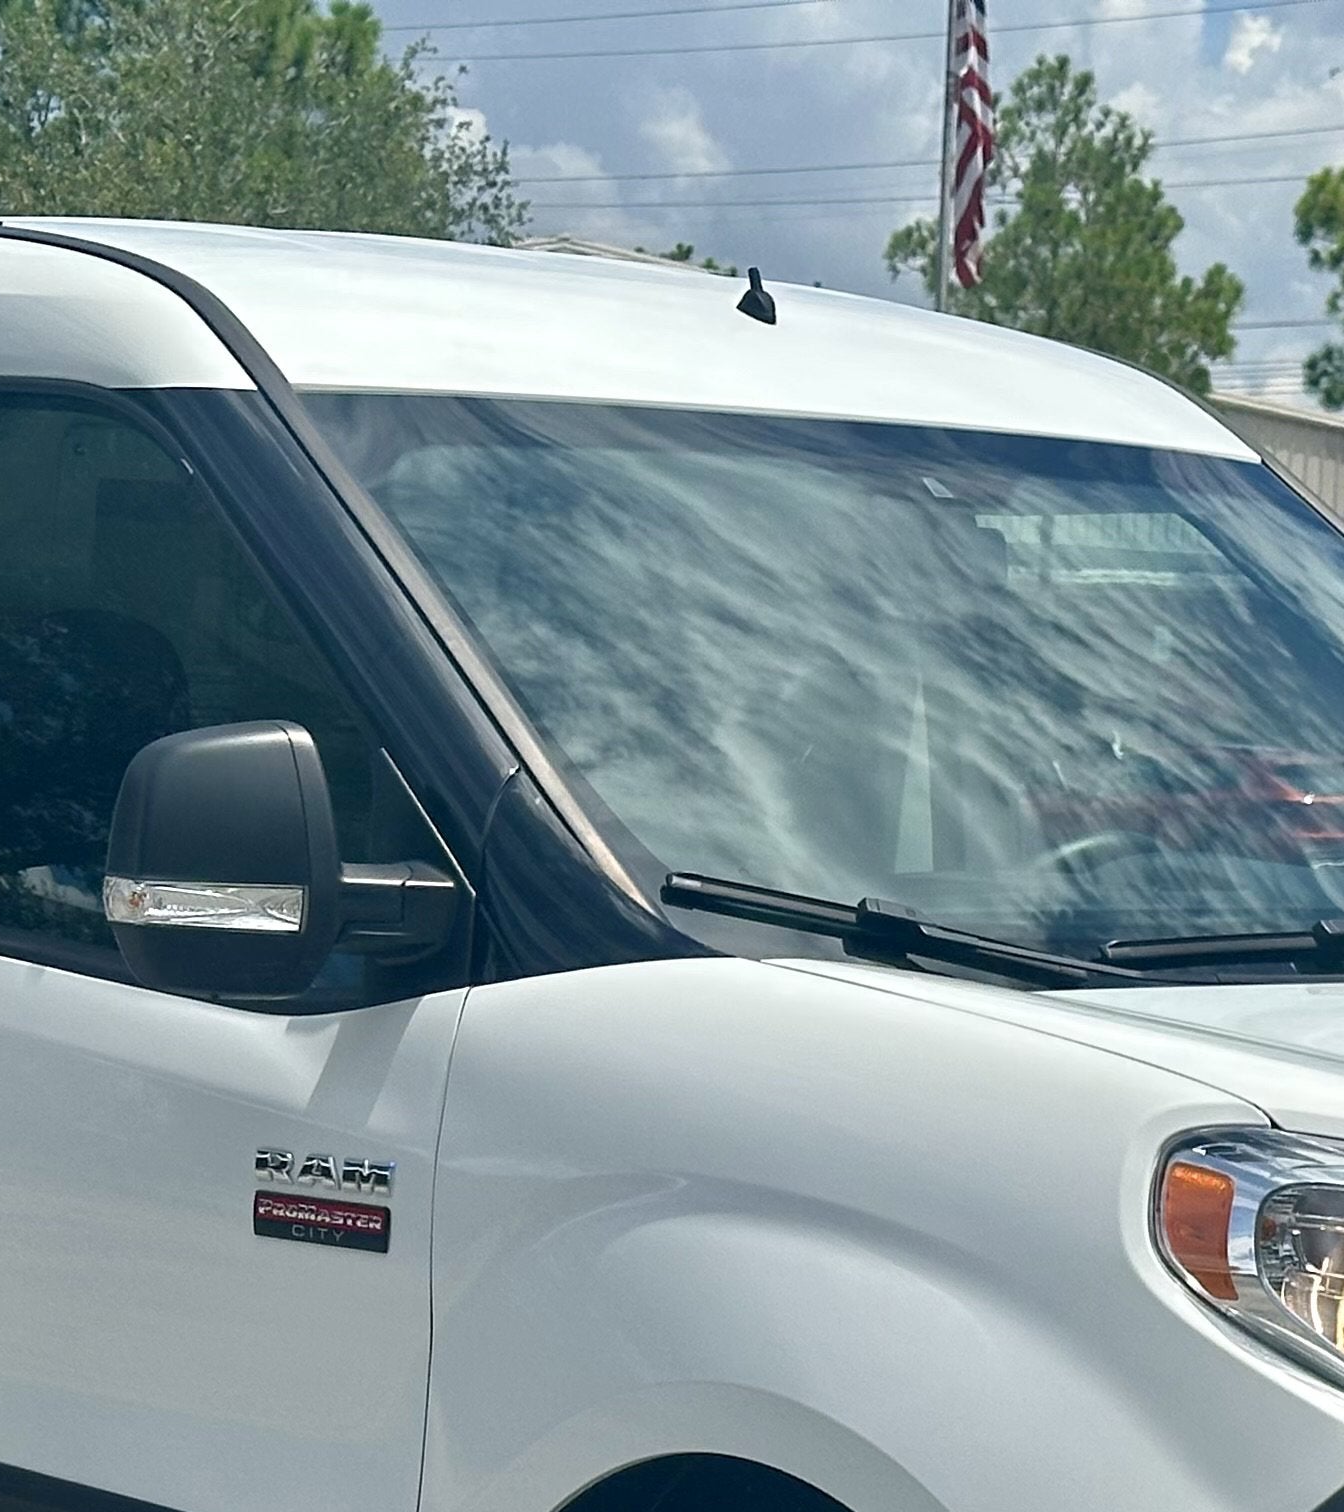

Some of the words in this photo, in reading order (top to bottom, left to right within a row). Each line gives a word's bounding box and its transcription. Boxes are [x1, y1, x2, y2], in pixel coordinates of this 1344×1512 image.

[254, 1149, 396, 1195] RAM
[258, 1198, 383, 1230] PROMASTER
[291, 1224, 344, 1241] CITY
